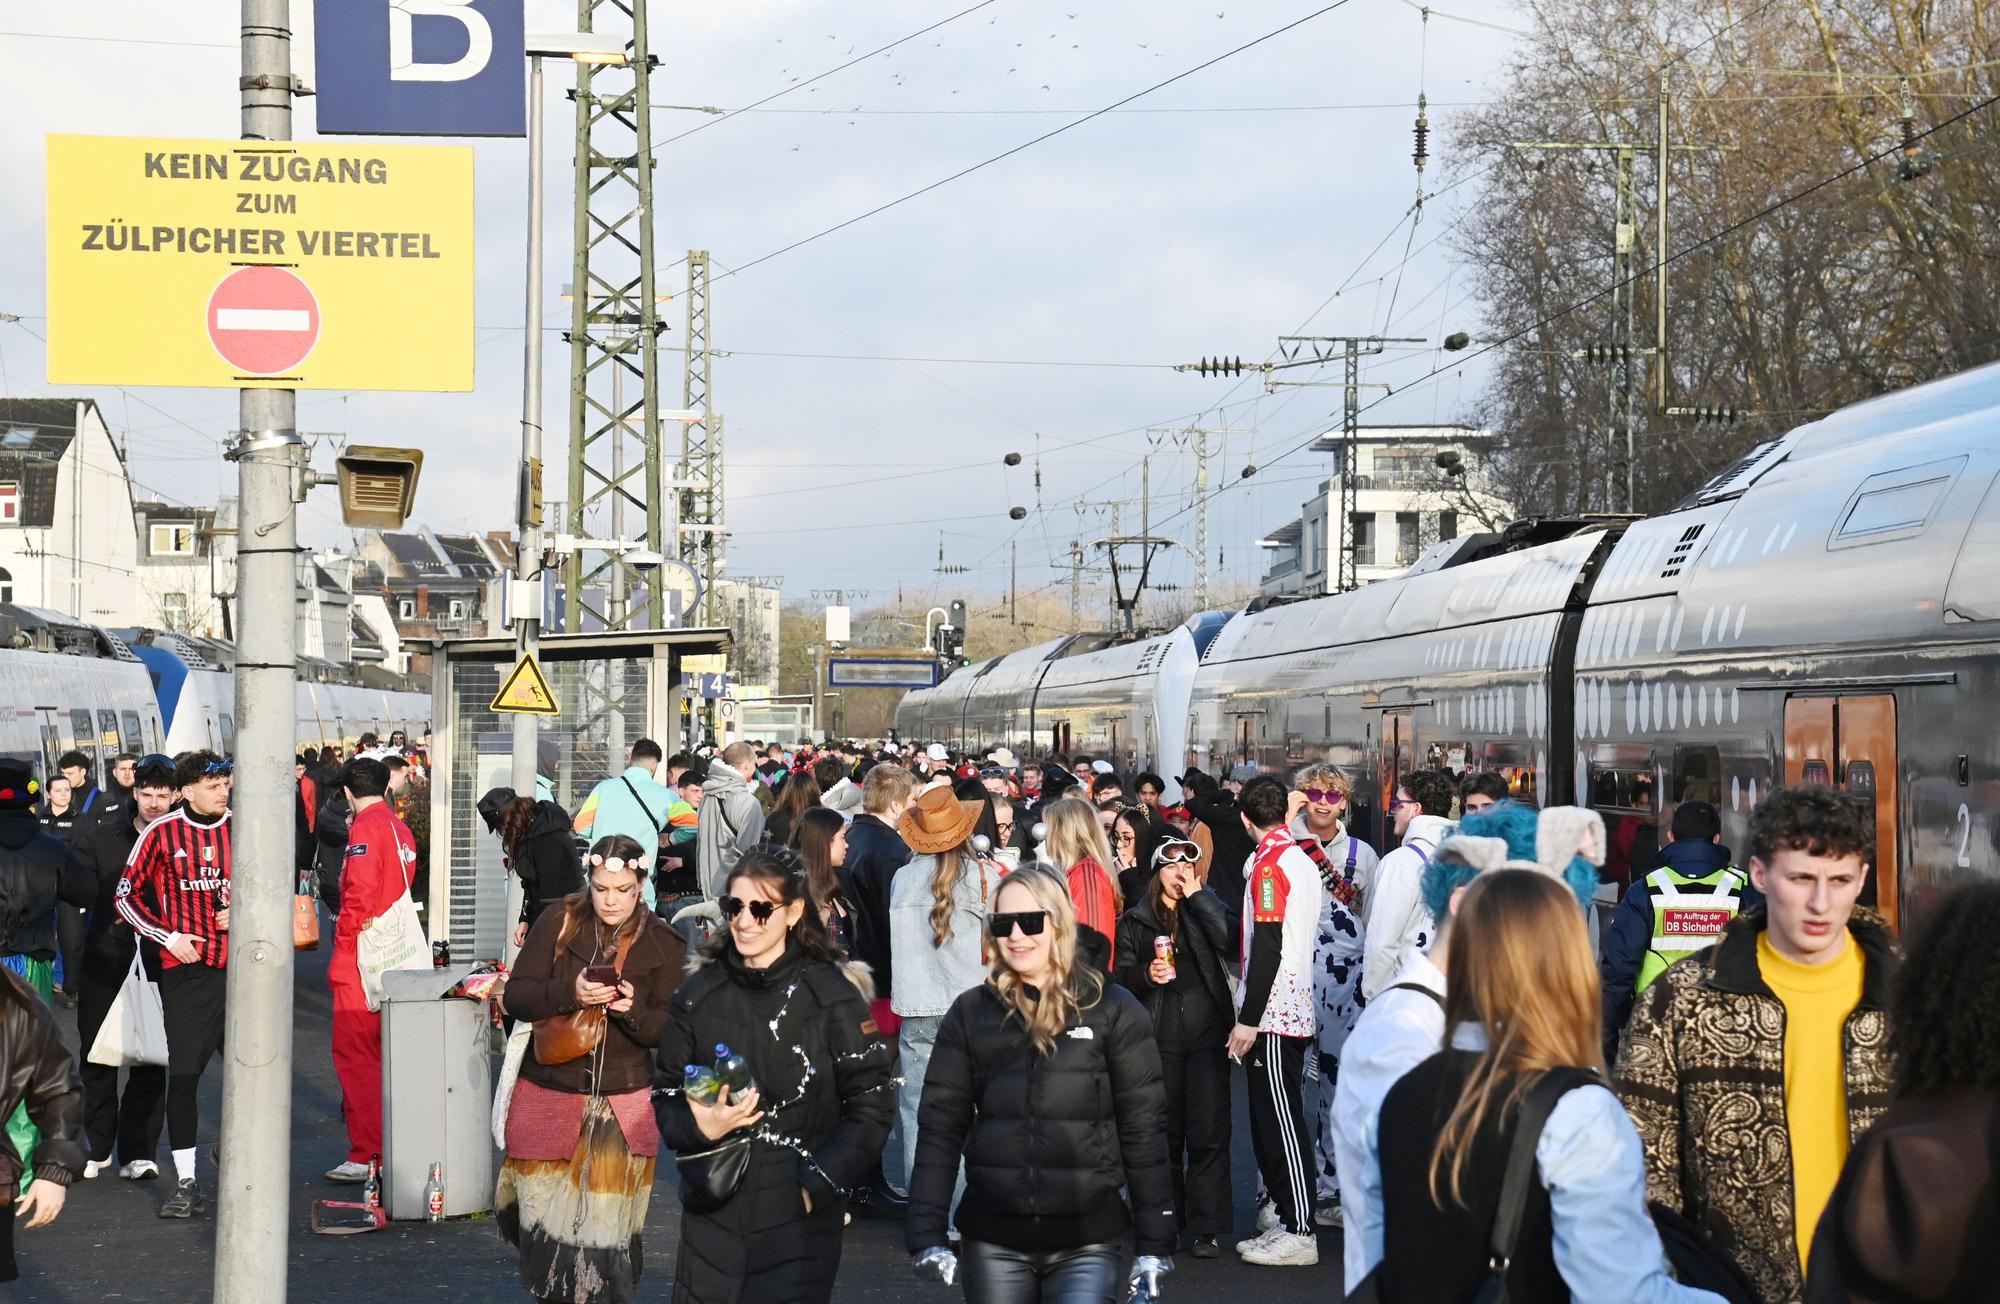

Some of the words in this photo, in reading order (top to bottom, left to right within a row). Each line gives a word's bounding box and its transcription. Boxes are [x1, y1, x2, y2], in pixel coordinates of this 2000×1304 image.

[389, 0, 493, 82] B
[144, 152, 228, 180] KEIN
[239, 155, 388, 185] ZUGANG
[236, 192, 297, 214] ZUM
[81, 217, 286, 255] ZÜLPICHER
[296, 229, 441, 259] VIERTEL
[710, 674, 723, 694] 4
[1958, 803, 1970, 868] 2
[200, 866, 221, 878] Fly
[1263, 882, 1272, 909] DEVK
[1666, 921, 1680, 932] DB
[1673, 912, 1683, 920] Im
[1683, 912, 1709, 922] Auftrag
[1710, 912, 1721, 920] der
